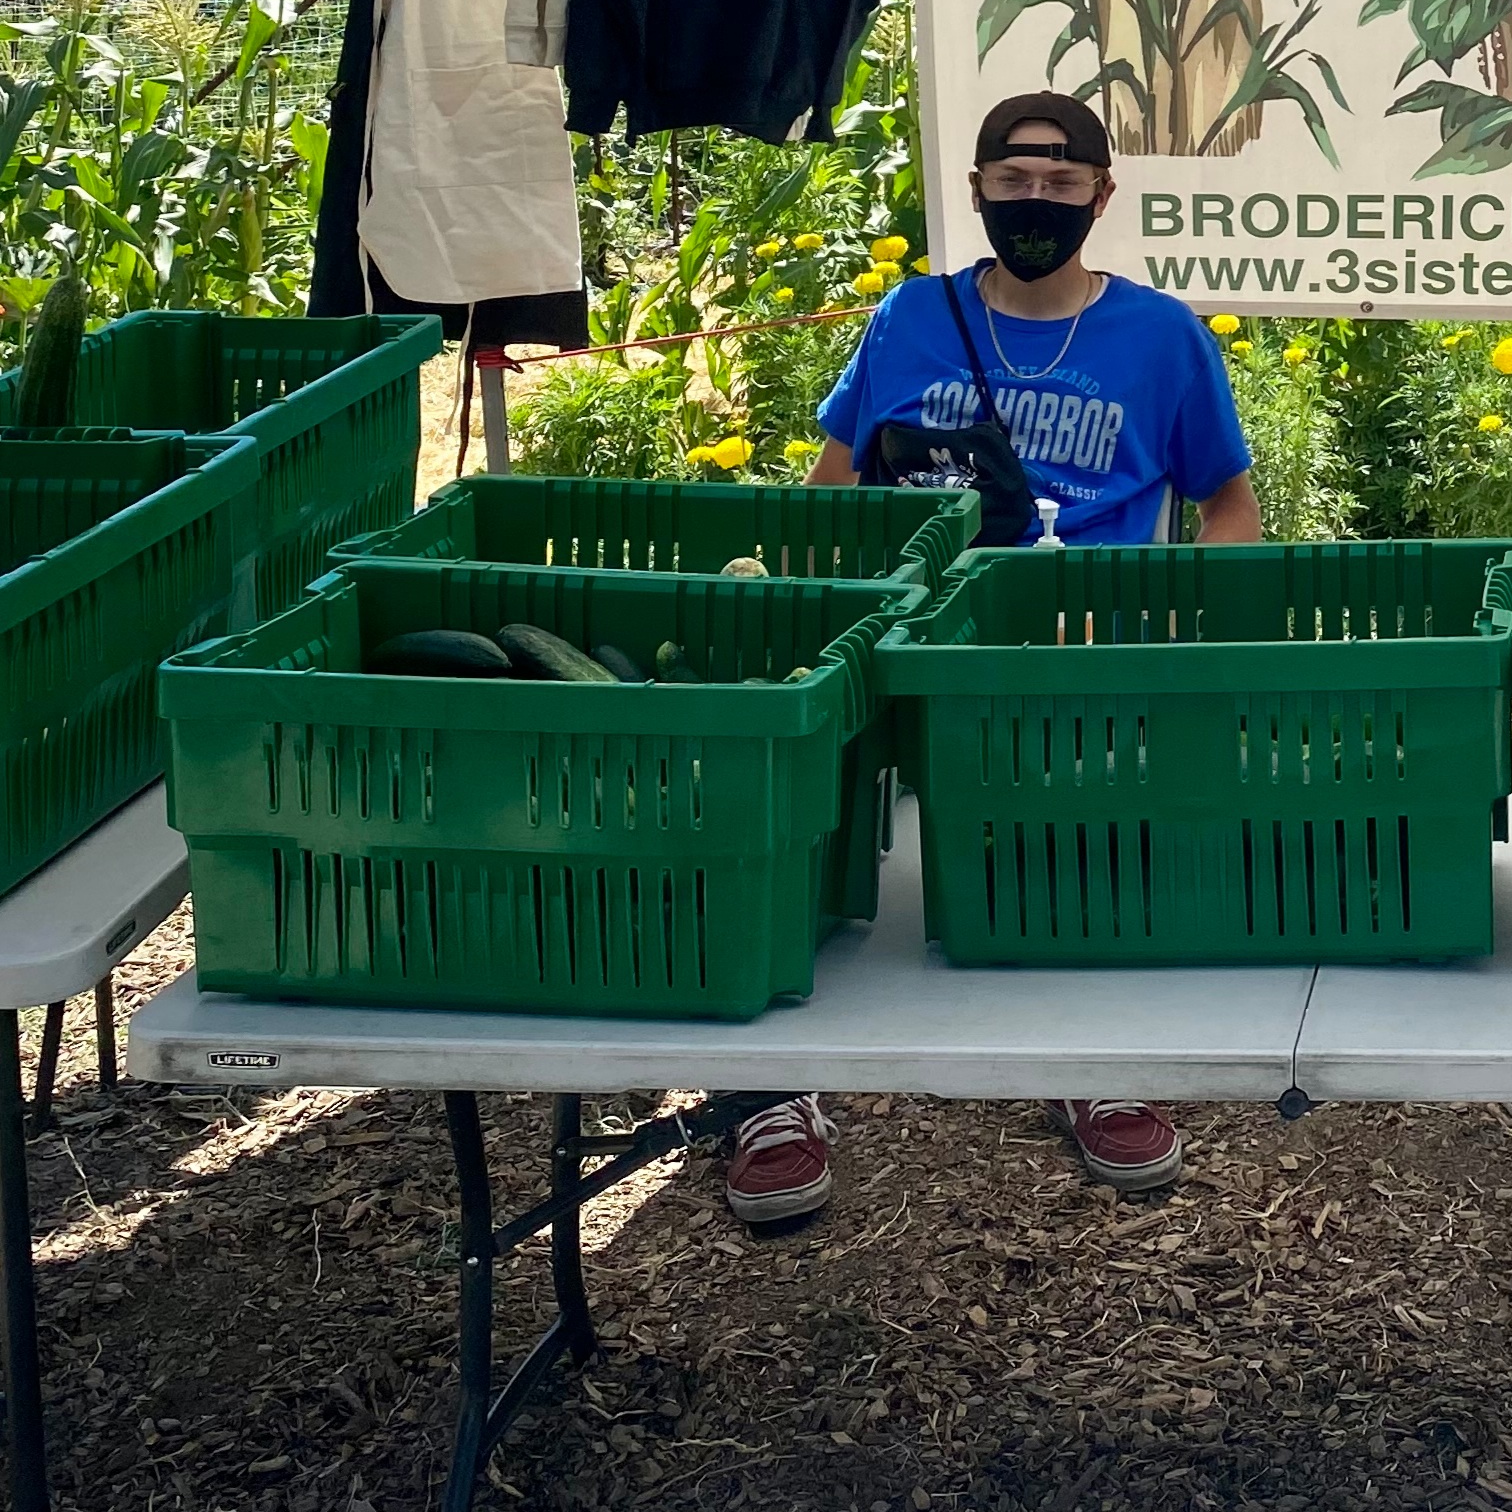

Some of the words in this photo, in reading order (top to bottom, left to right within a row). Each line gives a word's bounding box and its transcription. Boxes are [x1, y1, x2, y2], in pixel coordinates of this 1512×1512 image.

[1047, 368, 1101, 396] SLAND
[994, 387, 1124, 474] HARBOR
[216, 1054, 271, 1065] LIFETIME
